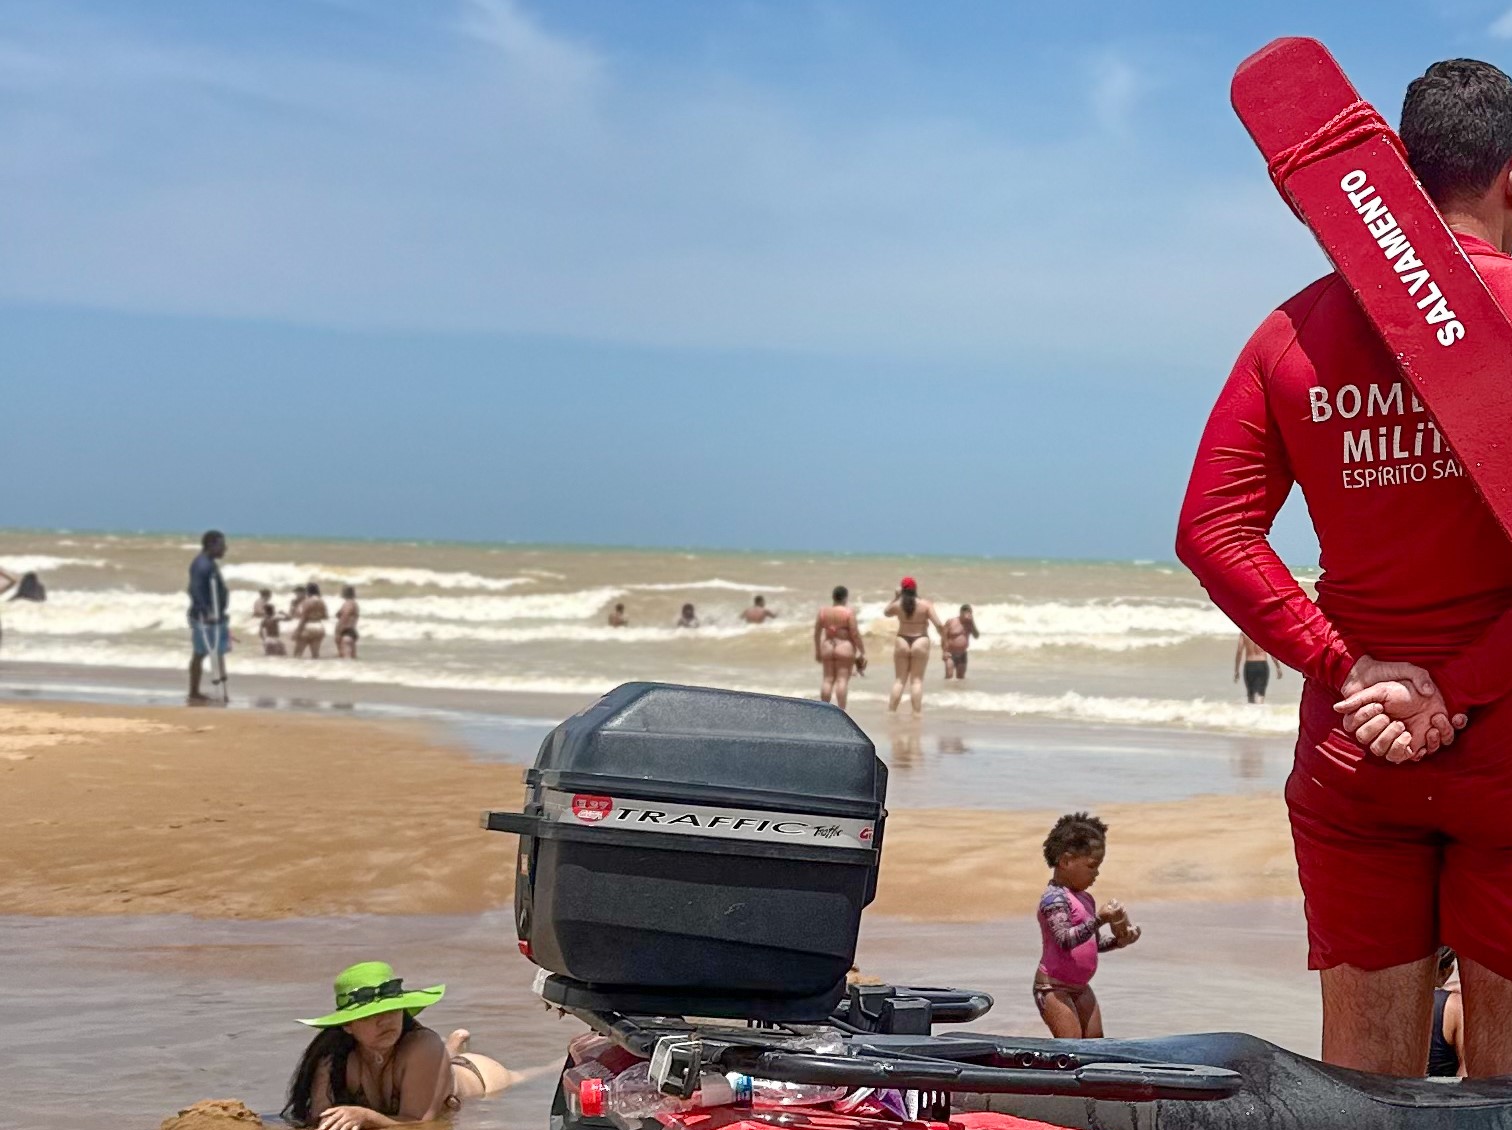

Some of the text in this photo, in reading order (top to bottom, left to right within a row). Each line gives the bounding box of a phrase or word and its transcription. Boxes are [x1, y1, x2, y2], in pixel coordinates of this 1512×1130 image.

[1340, 169, 1466, 347] SALVAMENTO
[1343, 422, 1451, 464] MiLiT
[617, 807, 810, 835] TRAFFIC
